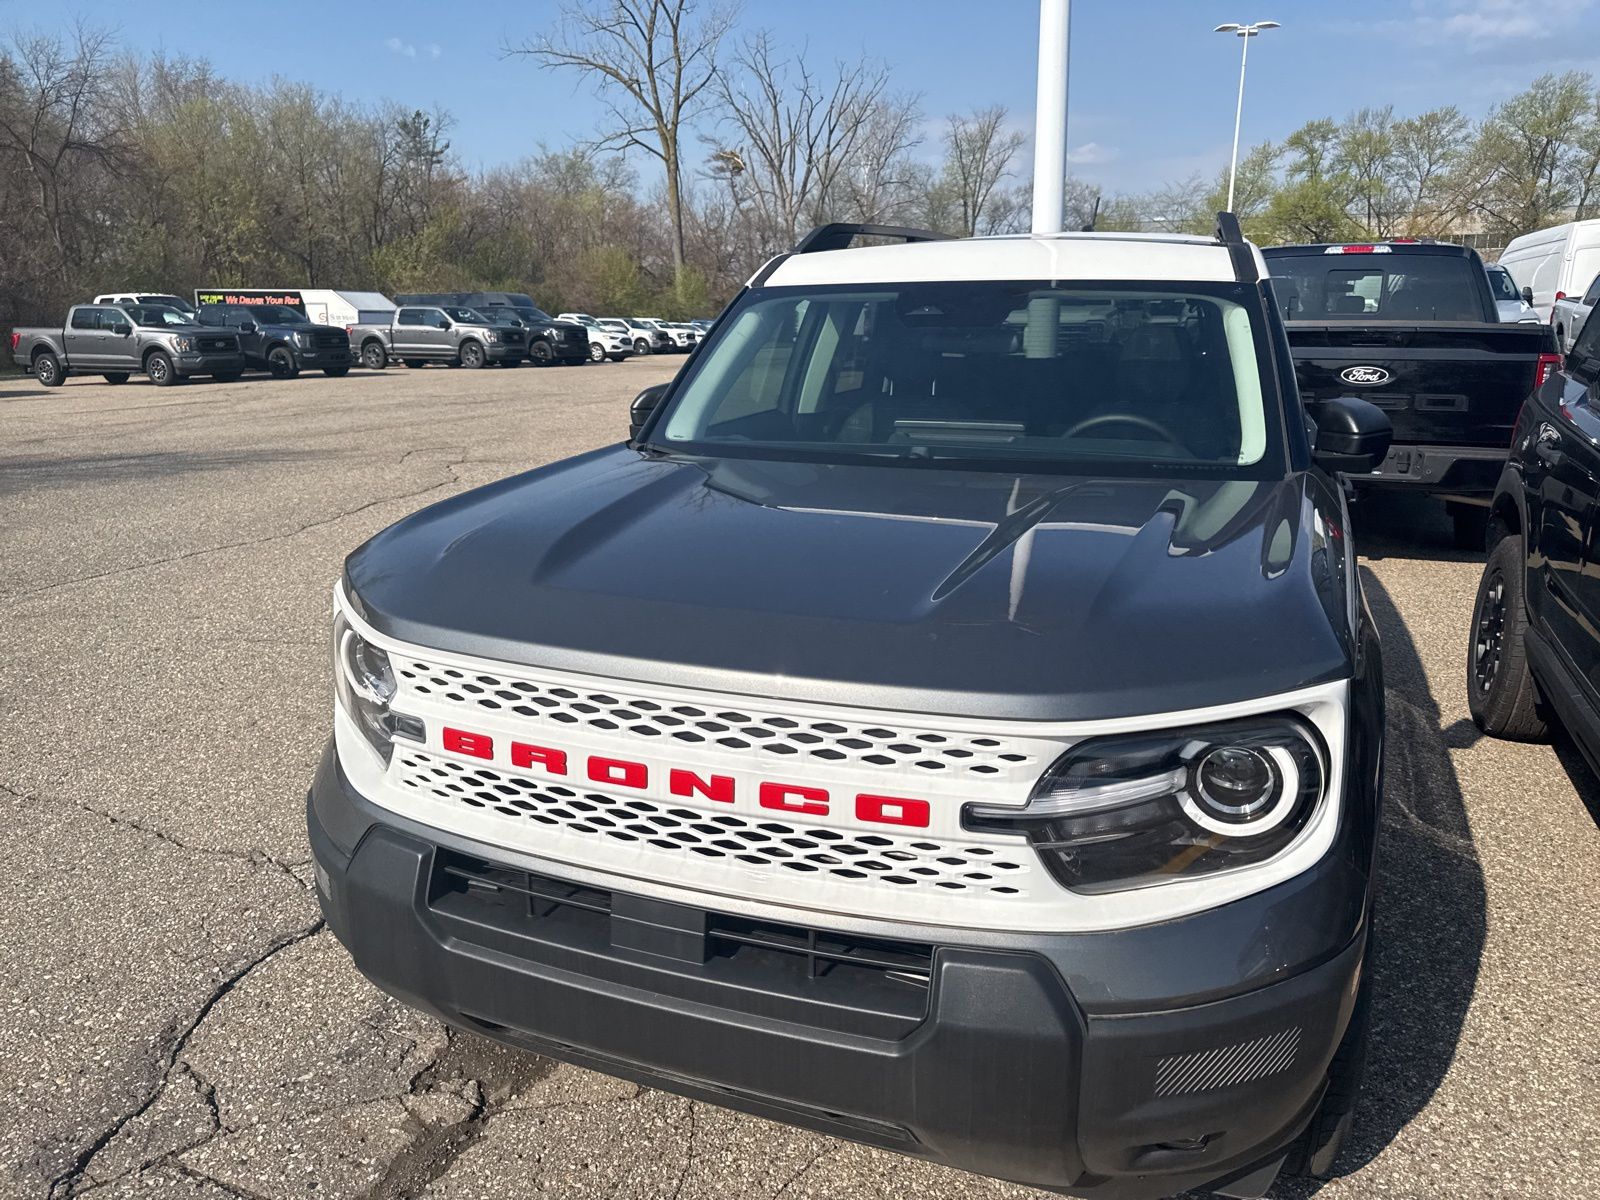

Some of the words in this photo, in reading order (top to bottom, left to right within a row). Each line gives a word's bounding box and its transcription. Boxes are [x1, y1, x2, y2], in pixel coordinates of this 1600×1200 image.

[238, 295, 264, 304] DELIVER
[264, 295, 283, 304] YOUR
[284, 295, 300, 304] RIDE
[1348, 368, 1381, 381] Ford
[442, 726, 930, 828] BRONCO
